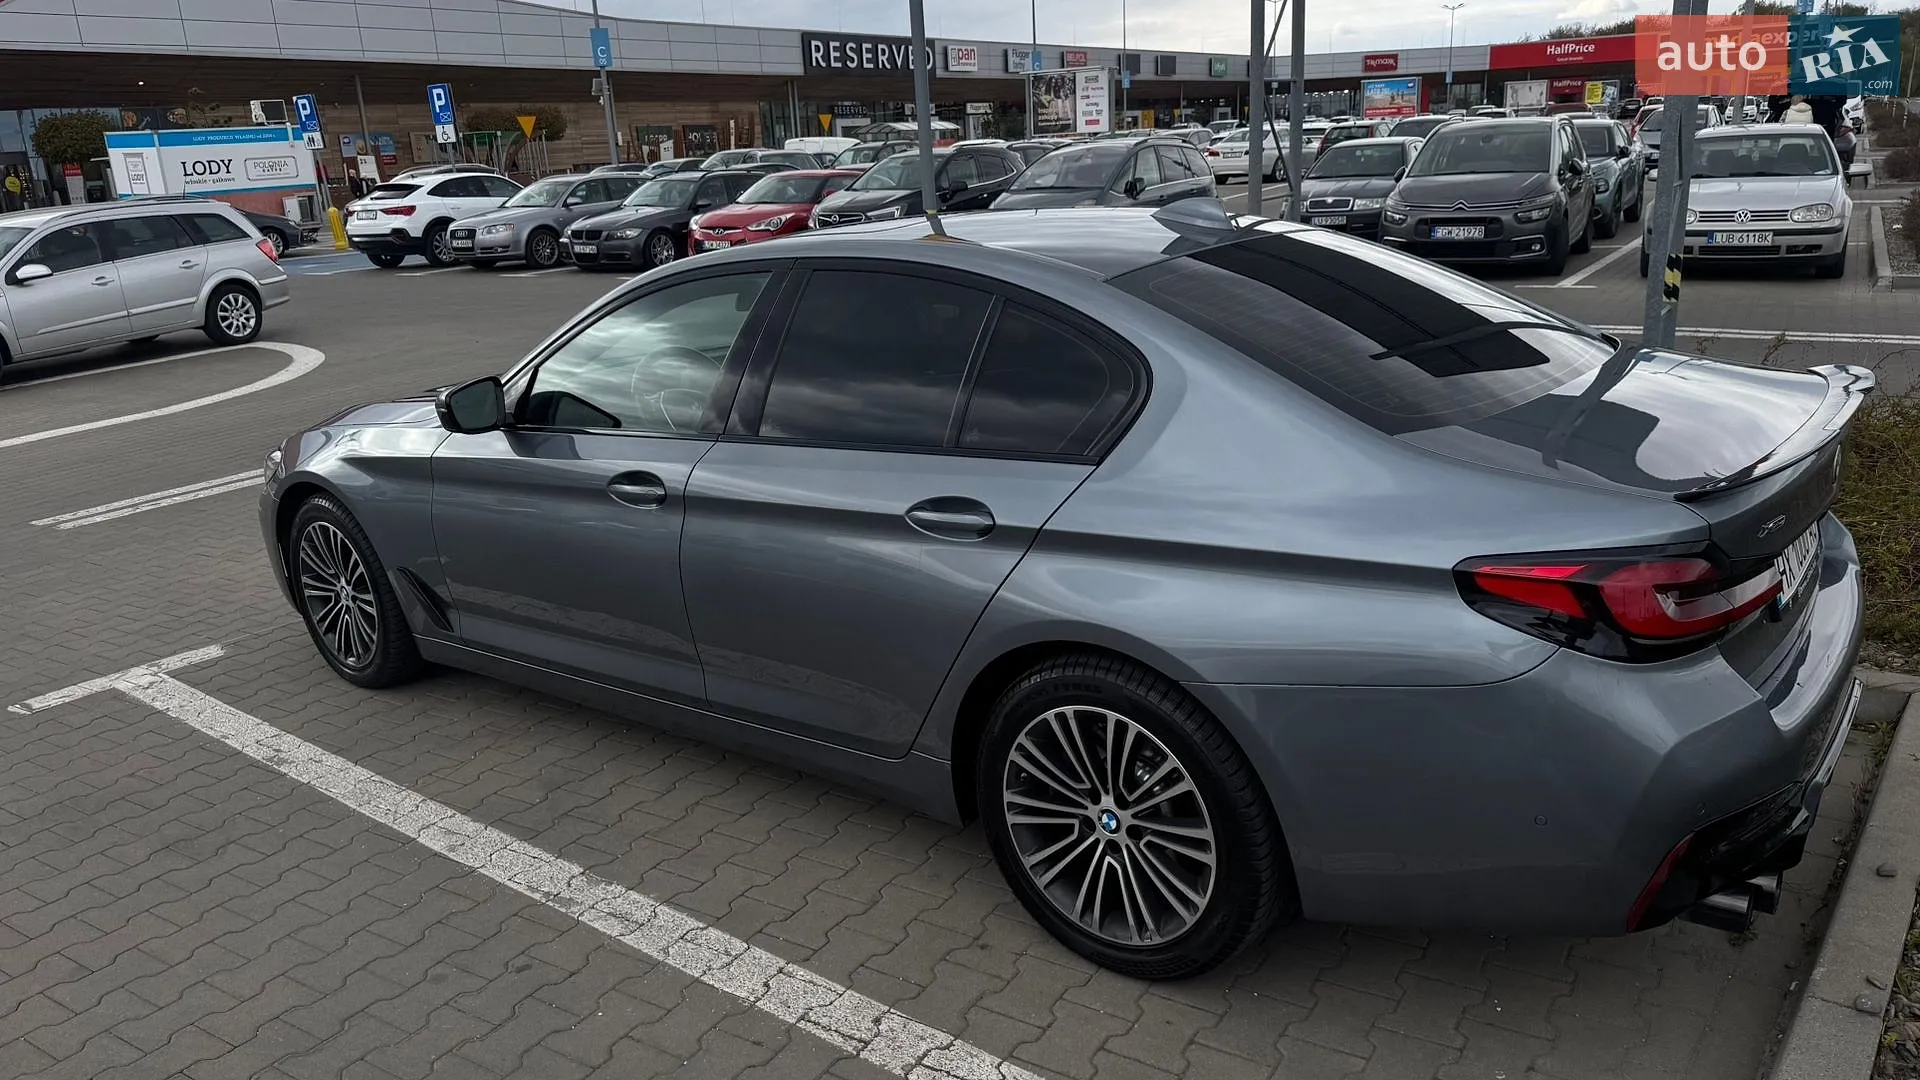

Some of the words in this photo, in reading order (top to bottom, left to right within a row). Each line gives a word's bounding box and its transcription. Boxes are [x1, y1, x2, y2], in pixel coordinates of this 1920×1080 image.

[1547, 43, 1595, 55] HalfPrice
[432, 88, 446, 113] P
[297, 98, 311, 121] P
[181, 159, 233, 177] LODY
[253, 160, 289, 169] POLONIA
[1457, 226, 1485, 238] 21978
[1714, 234, 1735, 243] LUB
[1737, 233, 1770, 243] 6118K
